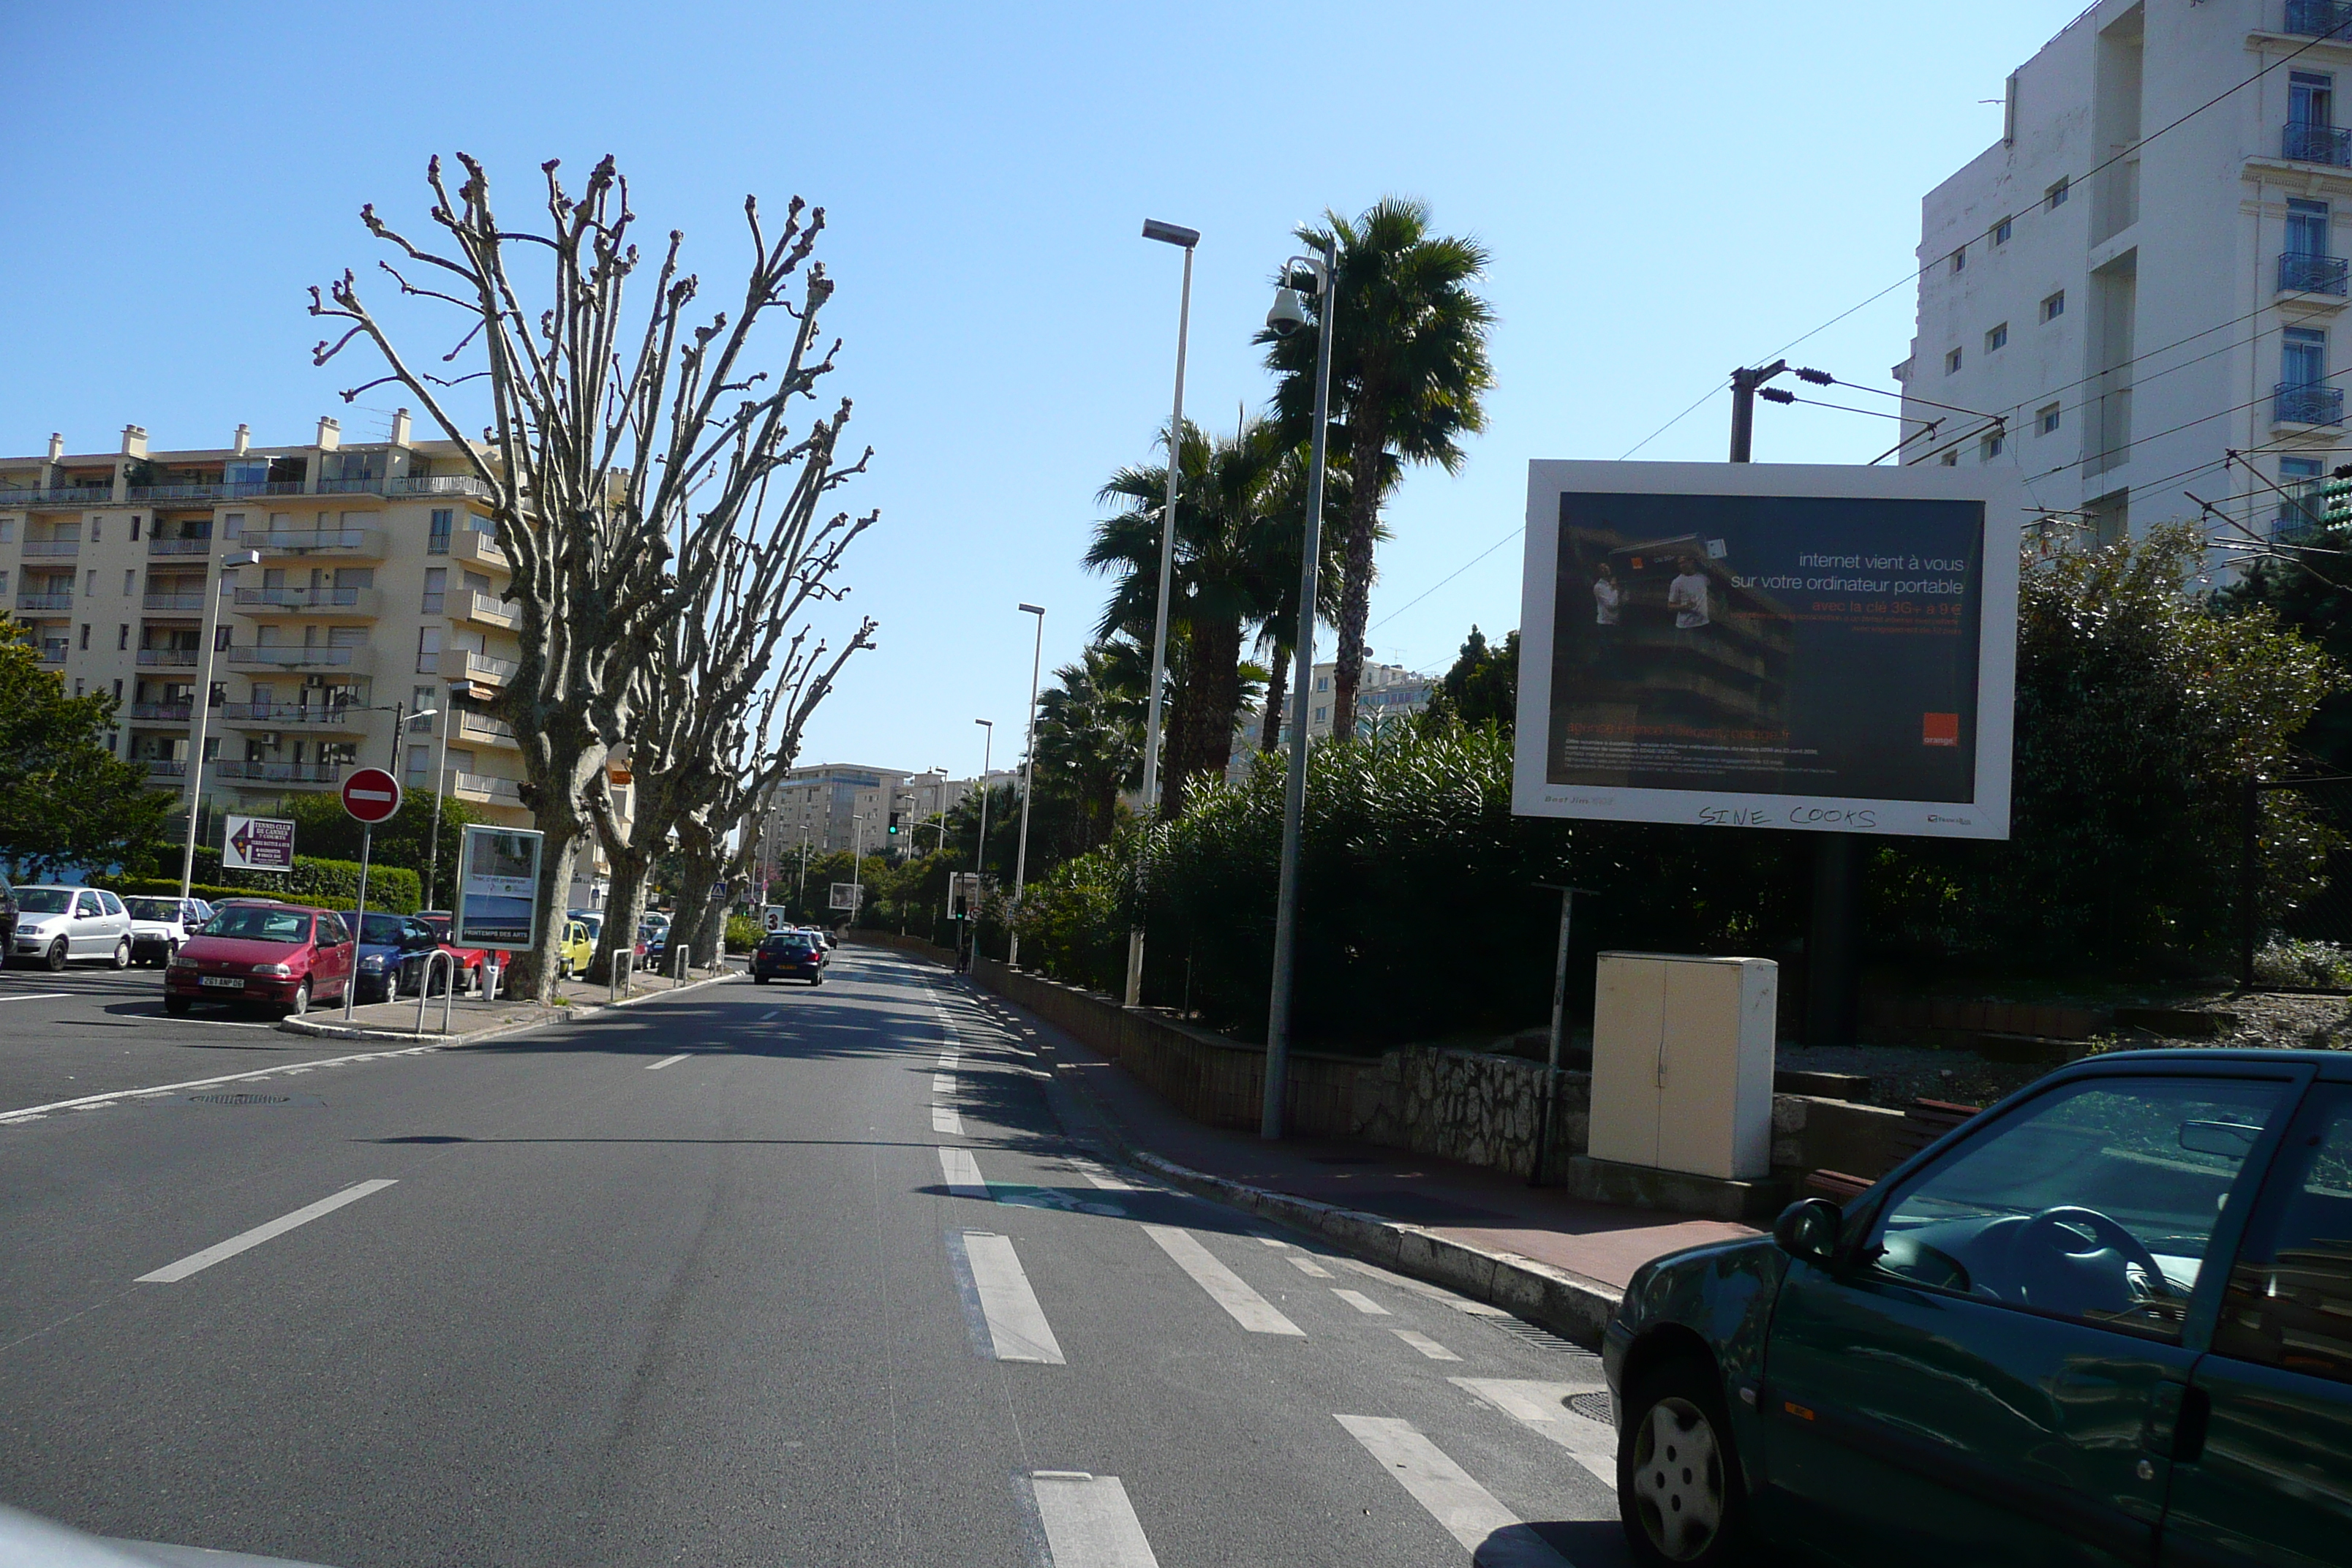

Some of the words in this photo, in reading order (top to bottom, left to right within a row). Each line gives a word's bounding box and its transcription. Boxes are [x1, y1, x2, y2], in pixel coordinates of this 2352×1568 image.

[1799, 552, 1861, 569] internet
[1865, 554, 1904, 570] vient
[1908, 554, 1920, 570] à
[1923, 558, 1964, 572] vous
[1730, 575, 1757, 589] sur
[1761, 575, 1802, 589] votre
[1806, 575, 1890, 592] ordinateur
[1894, 578, 1964, 596] portable
[1812, 601, 1846, 612] avec
[1850, 600, 1862, 613] la
[1866, 600, 1887, 614] clé
[1923, 737, 1953, 747] orange
[1699, 807, 1772, 826] SINE
[1790, 807, 1877, 828] COOKS
